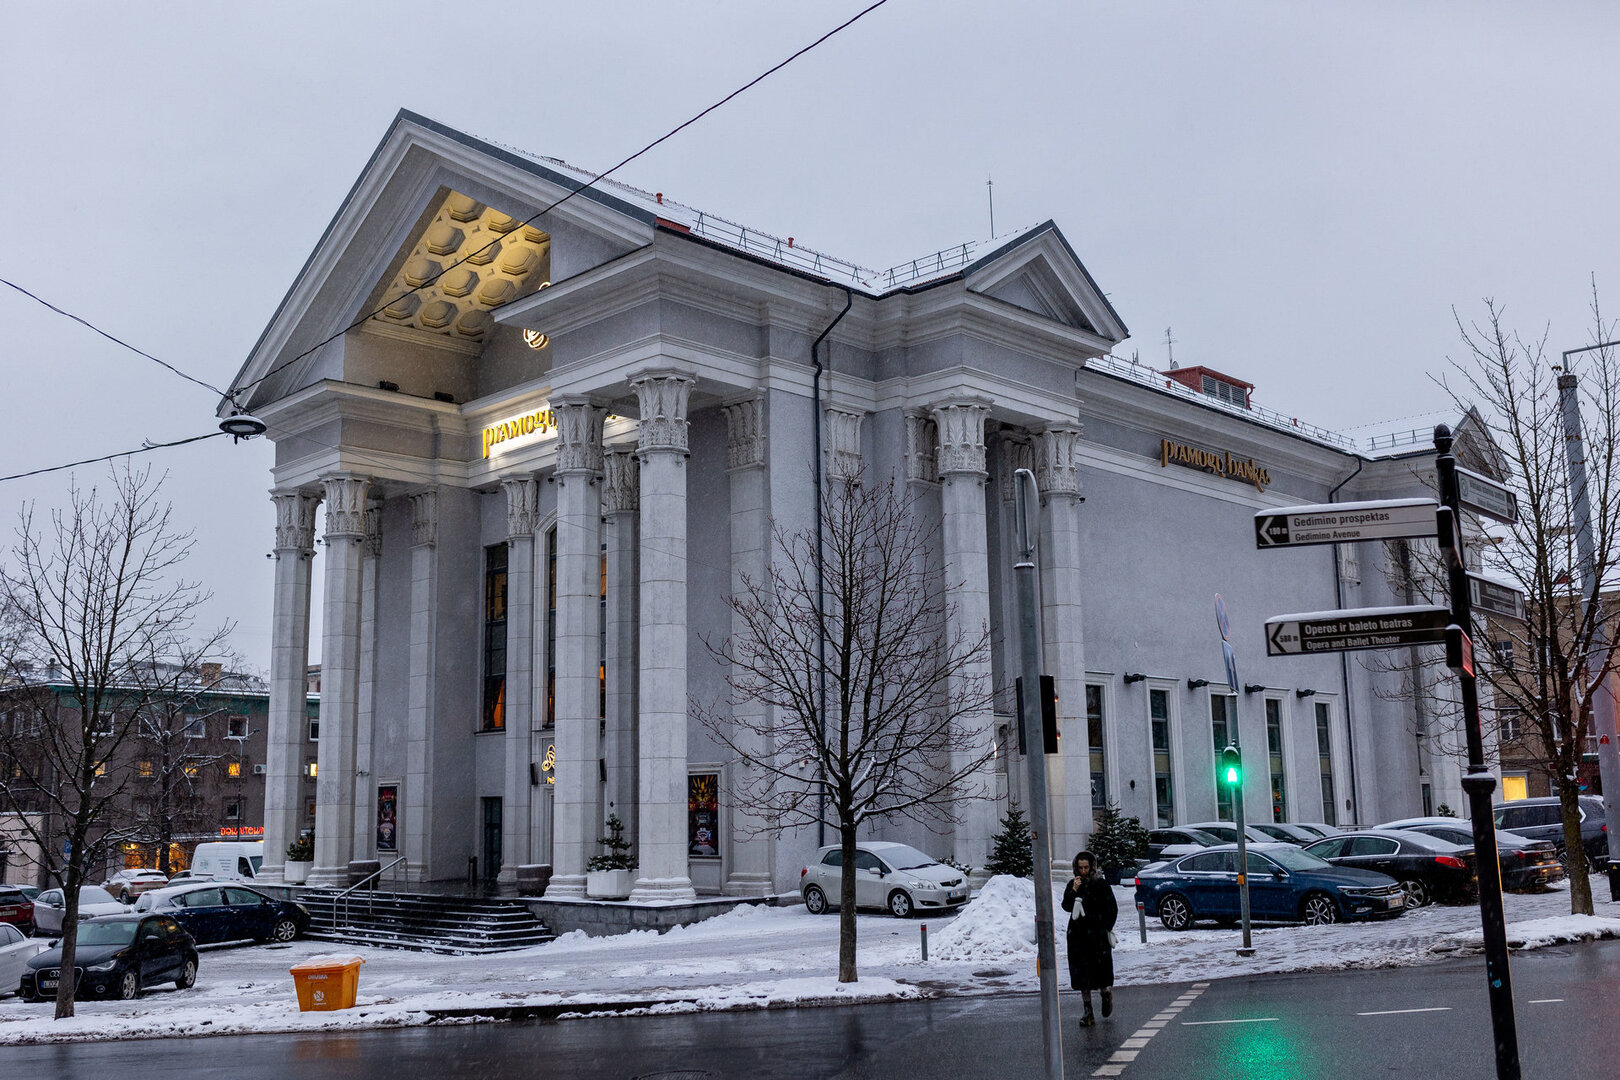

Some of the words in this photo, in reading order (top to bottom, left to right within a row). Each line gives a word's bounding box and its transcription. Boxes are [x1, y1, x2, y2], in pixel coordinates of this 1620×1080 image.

[1294, 517, 1337, 527] Gedimino
[1340, 512, 1390, 528] prospektas
[1295, 532, 1331, 541] Gedimino
[1332, 530, 1361, 539] Avenue
[1304, 624, 1337, 636] Operos
[1339, 623, 1347, 632] ir
[1350, 620, 1378, 631] baleto
[1380, 618, 1413, 629] teatras
[1306, 641, 1330, 651] Opera
[1331, 638, 1345, 648] and
[1347, 637, 1370, 647] Ballet
[1371, 635, 1400, 645] Theater
